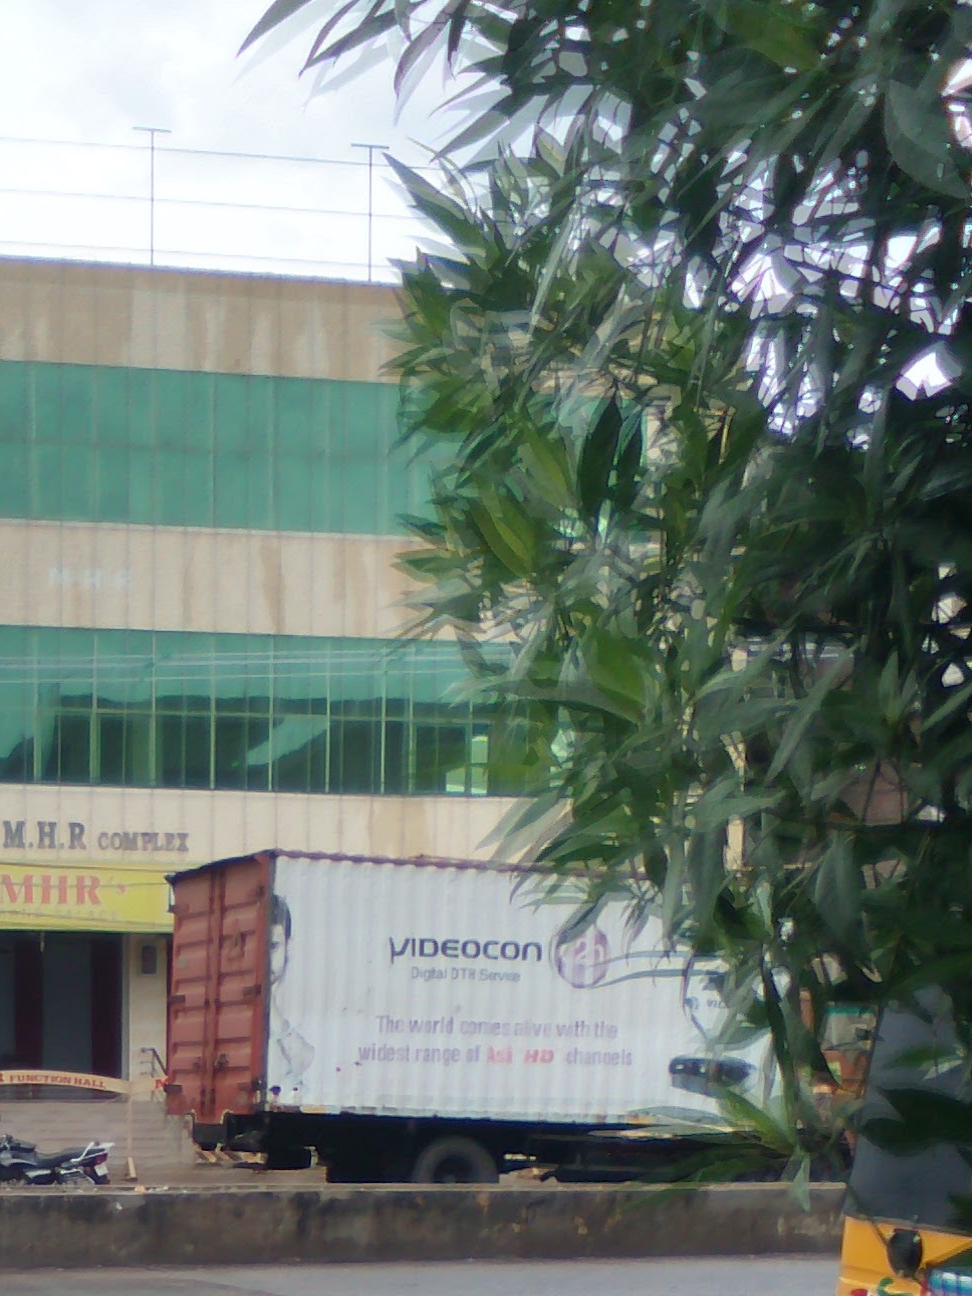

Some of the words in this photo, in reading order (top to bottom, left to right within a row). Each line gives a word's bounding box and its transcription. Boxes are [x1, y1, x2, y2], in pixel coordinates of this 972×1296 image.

[2, 820, 88, 850] M.H.R
[97, 831, 190, 852] COMPLEX
[0, 872, 102, 906] MHR
[411, 966, 447, 982] Digital
[479, 968, 522, 984] Service
[376, 1015, 404, 1034] The
[409, 1016, 454, 1035] world
[459, 1018, 511, 1037] comes
[556, 1020, 591, 1039] with
[593, 1021, 619, 1039] the
[358, 1043, 410, 1062] widest
[415, 1046, 461, 1067] range
[465, 1045, 482, 1063] of
[523, 1048, 555, 1064] HD
[565, 1047, 633, 1067] channels
[9, 1073, 72, 1085] FUNCTION
[72, 1076, 107, 1089] HALL
